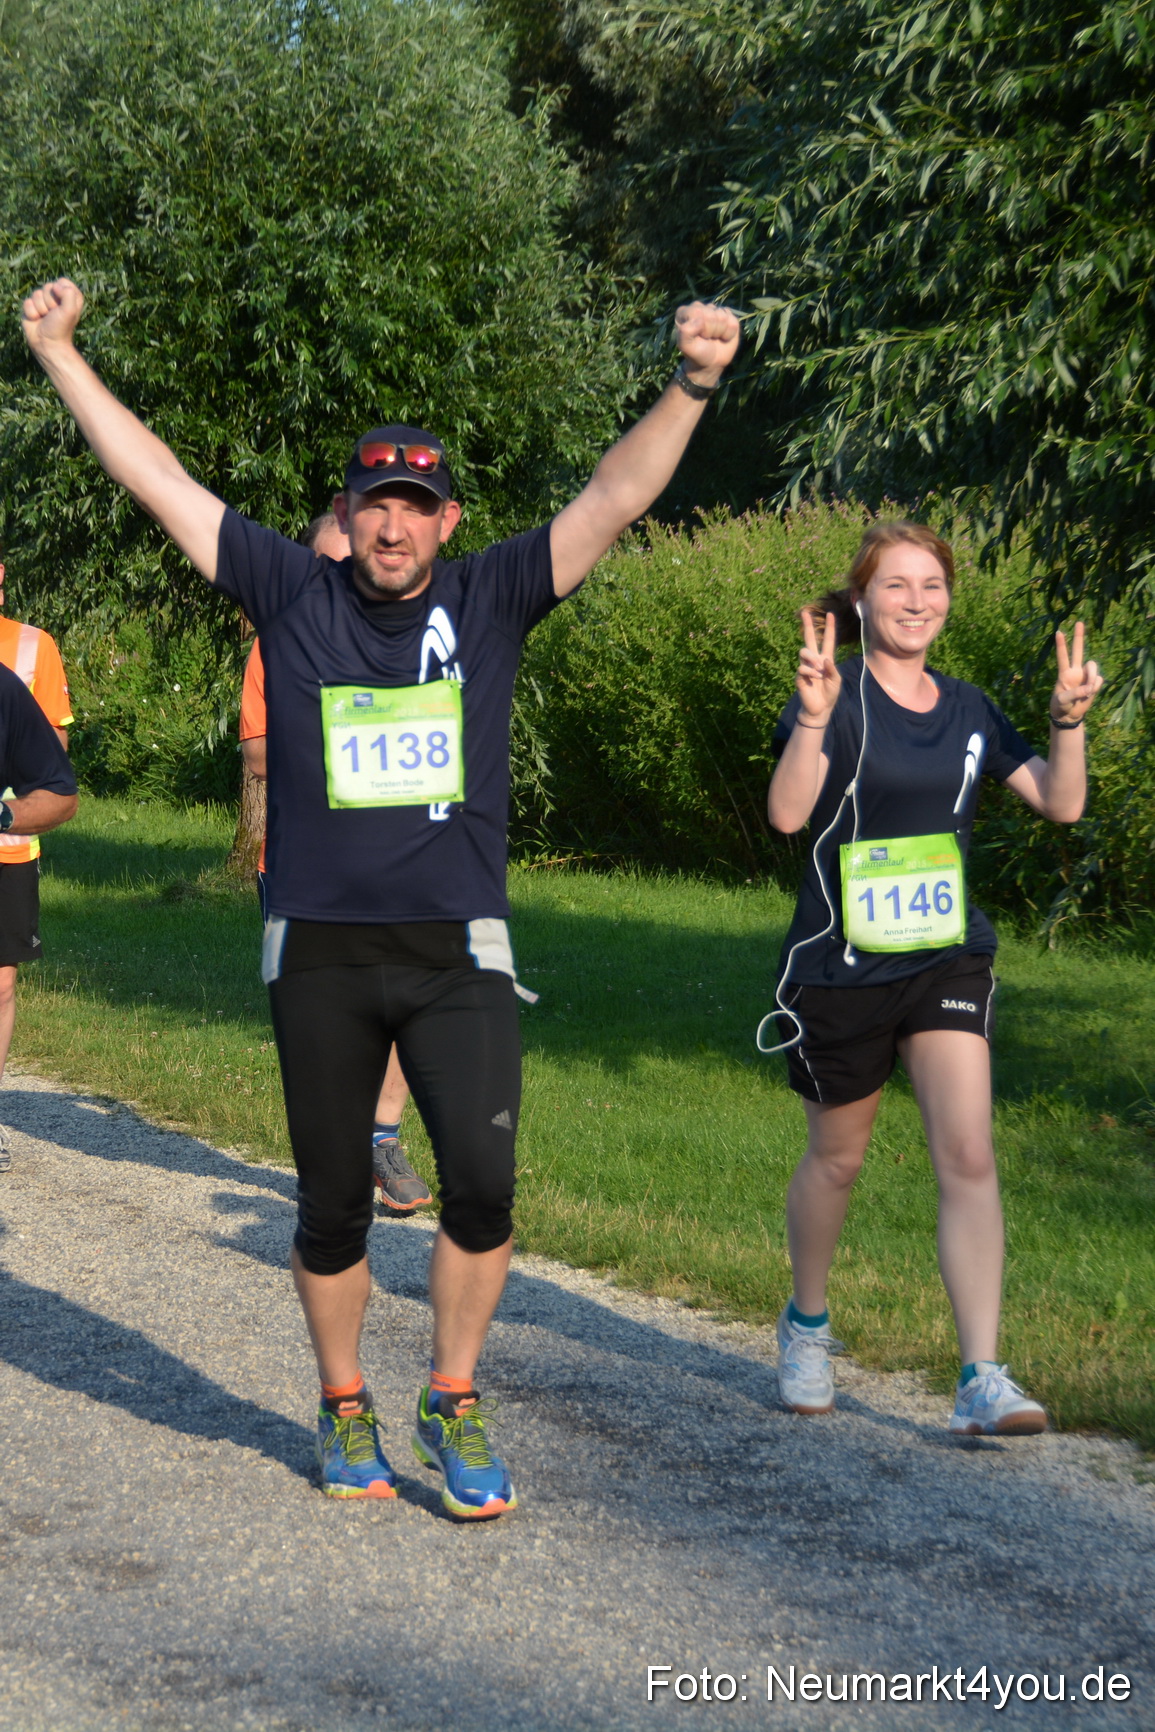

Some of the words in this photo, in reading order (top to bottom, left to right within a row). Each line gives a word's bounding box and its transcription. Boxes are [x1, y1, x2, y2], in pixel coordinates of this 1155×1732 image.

[341, 730, 450, 773] 1138
[370, 780, 401, 789] Torsten
[402, 779, 424, 787] Bode
[861, 857, 905, 869] firmenlauf
[858, 880, 953, 922] 1146
[904, 925, 933, 935] Freihart
[941, 999, 977, 1013] JAKO
